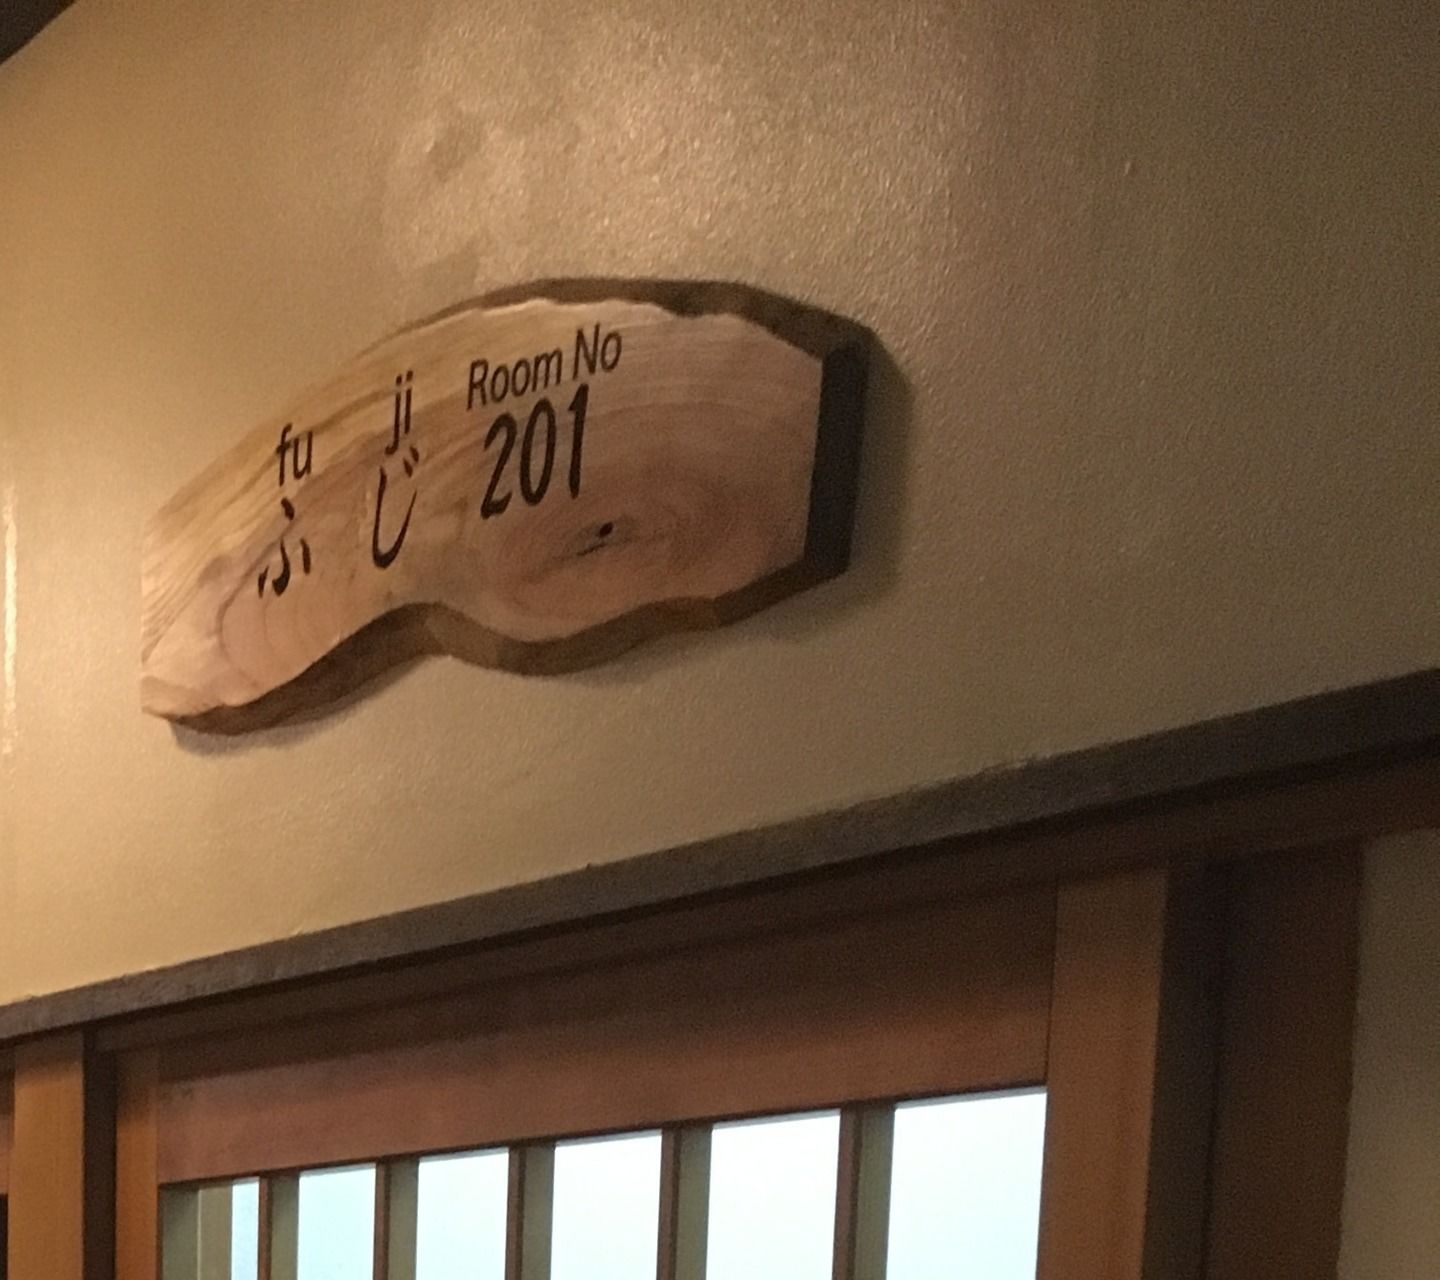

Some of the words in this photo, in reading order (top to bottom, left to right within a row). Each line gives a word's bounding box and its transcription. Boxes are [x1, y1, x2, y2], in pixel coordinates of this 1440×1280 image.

[467, 347, 563, 410] Room
[573, 322, 624, 378] No
[480, 383, 590, 519] 201
